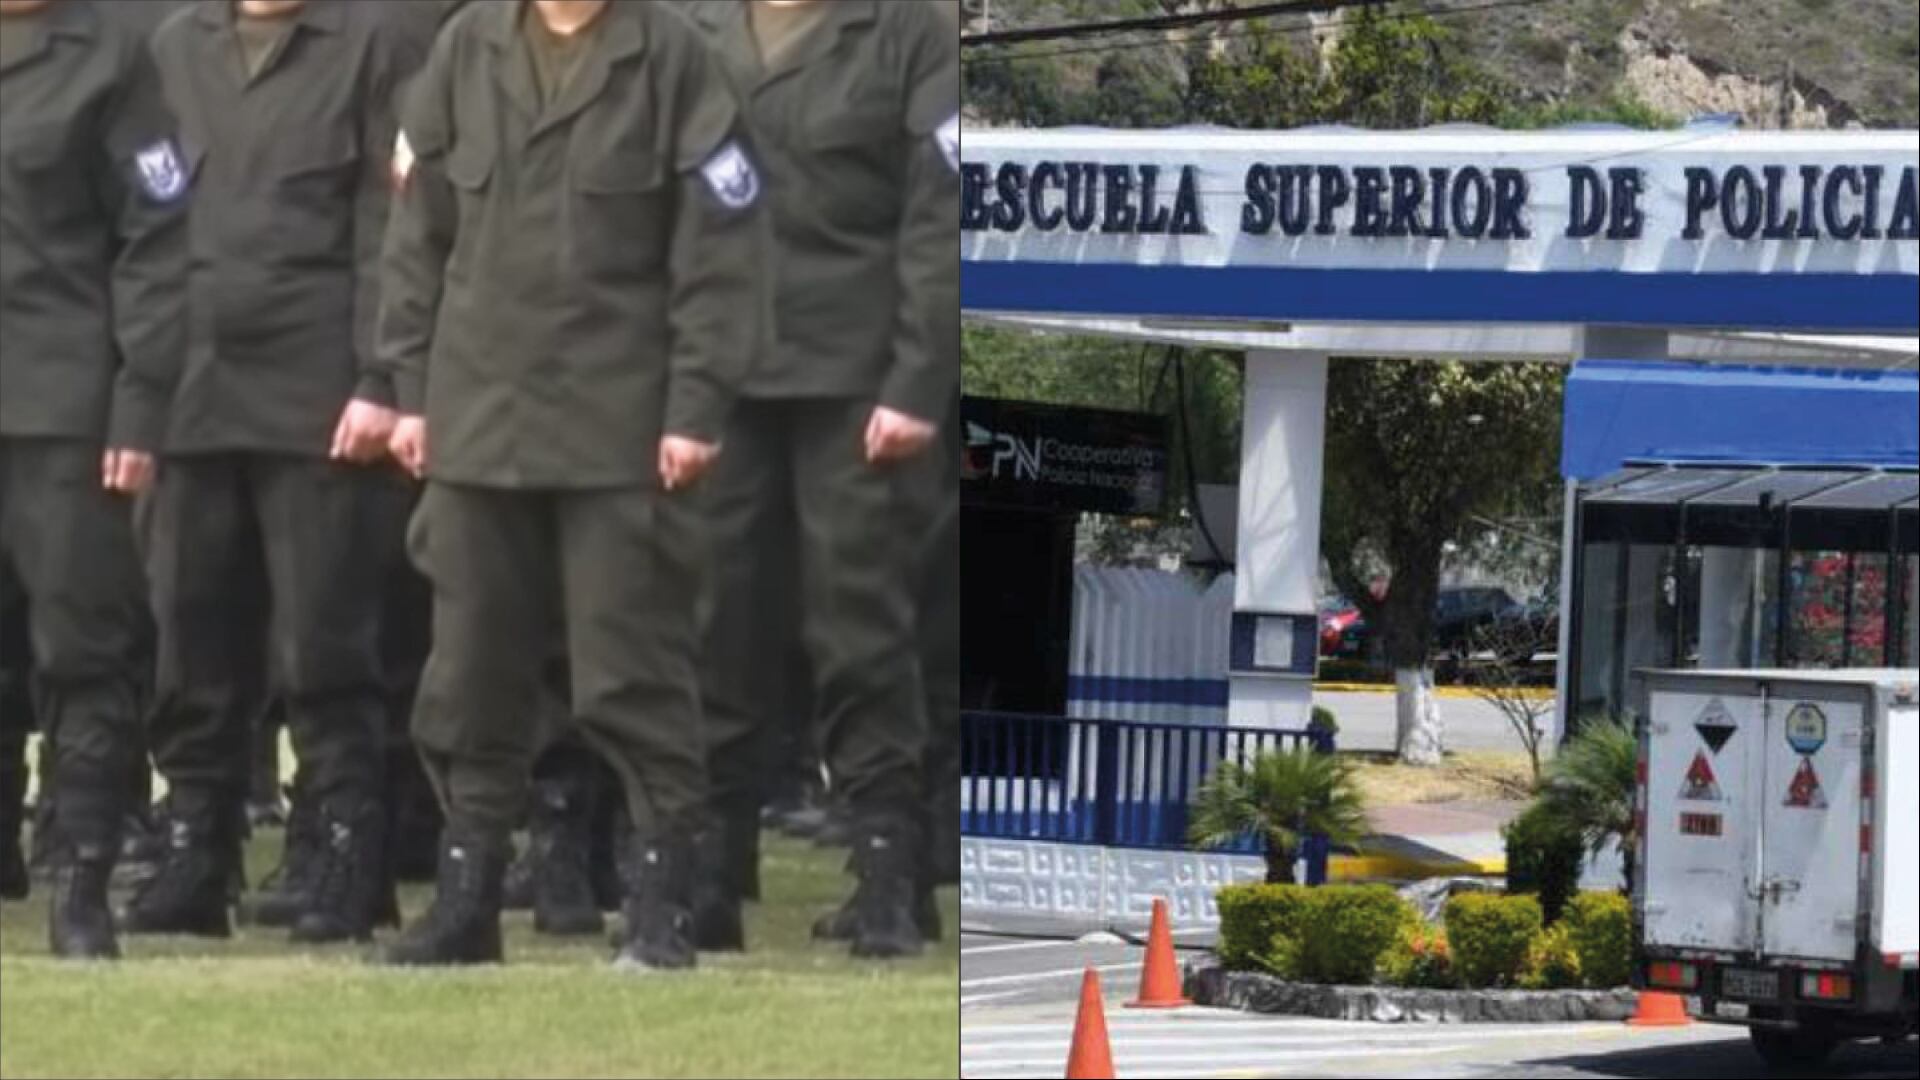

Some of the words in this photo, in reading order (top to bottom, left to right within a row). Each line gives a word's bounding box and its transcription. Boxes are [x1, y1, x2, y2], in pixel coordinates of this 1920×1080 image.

[961, 160, 1208, 234] ESCUELA
[1241, 163, 1532, 240] SUPERIOR
[1564, 165, 1646, 240] DE
[1681, 165, 1919, 241] POLICIA
